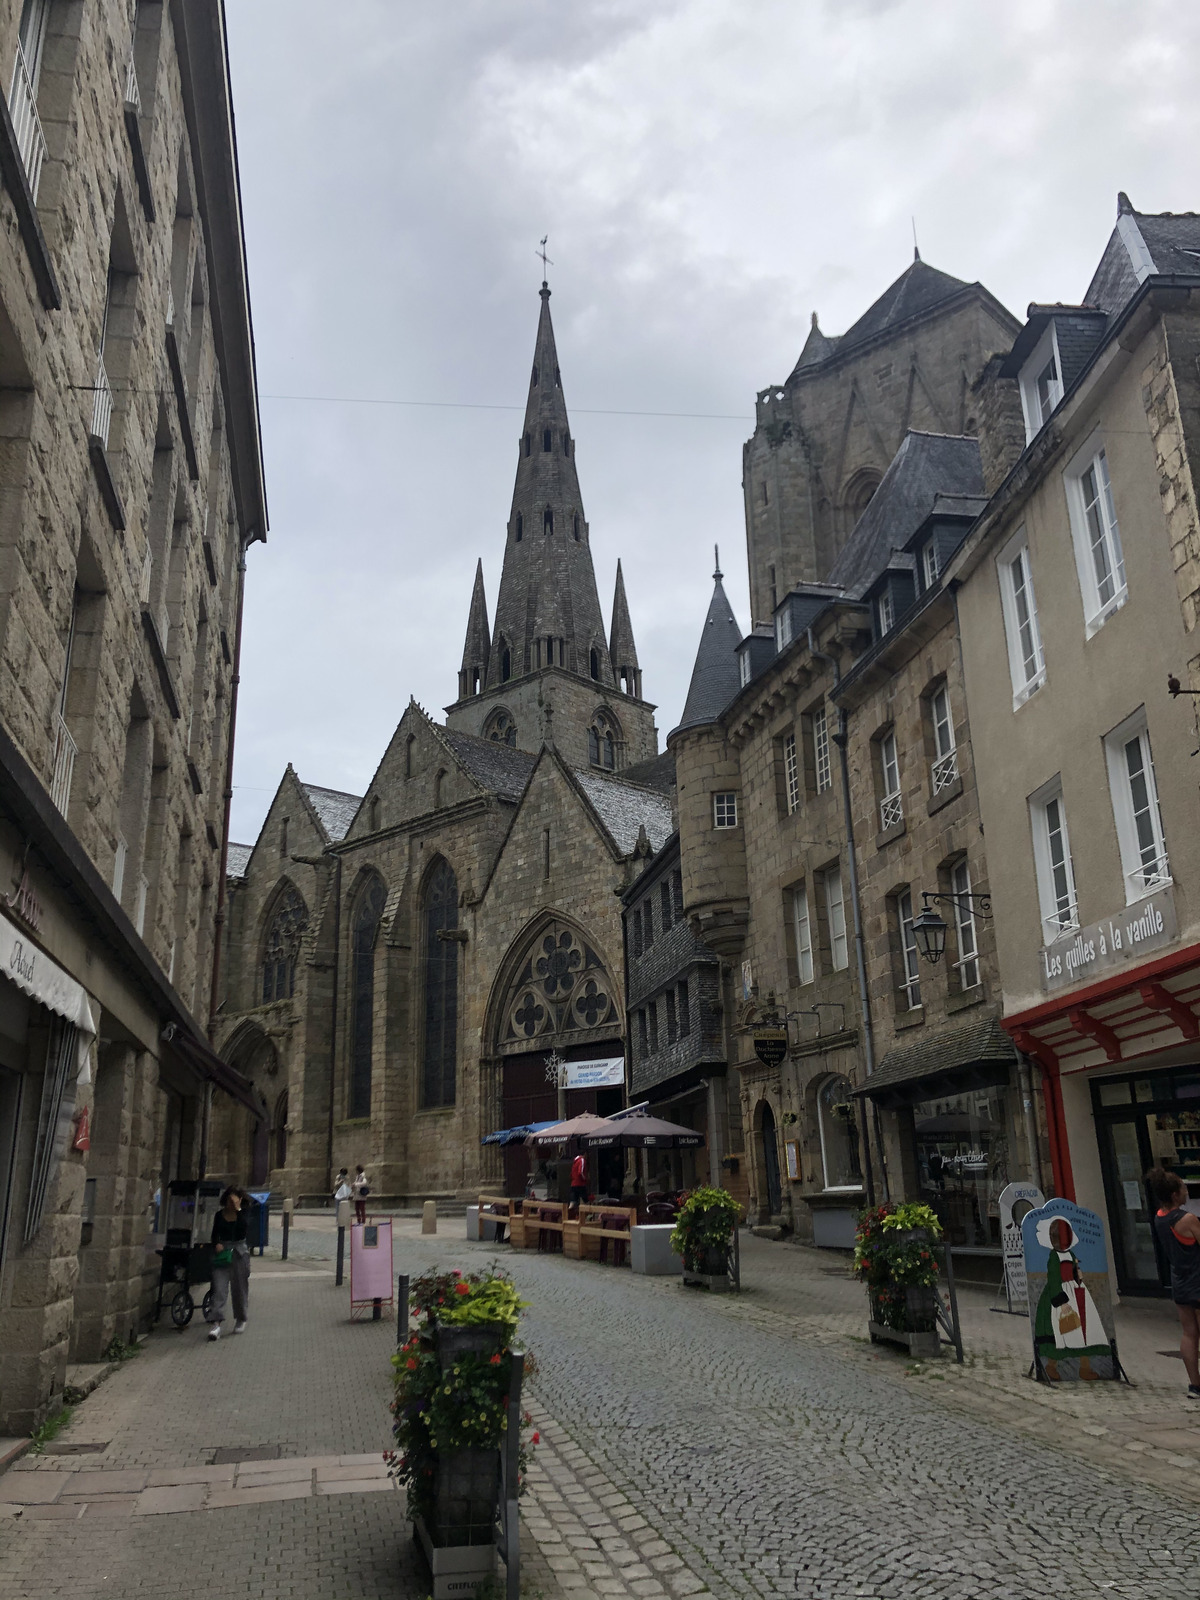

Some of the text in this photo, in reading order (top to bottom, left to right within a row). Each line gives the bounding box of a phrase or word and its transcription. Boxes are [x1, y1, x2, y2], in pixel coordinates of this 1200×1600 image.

[1045, 903, 1163, 978] Les quilles à la vanille
